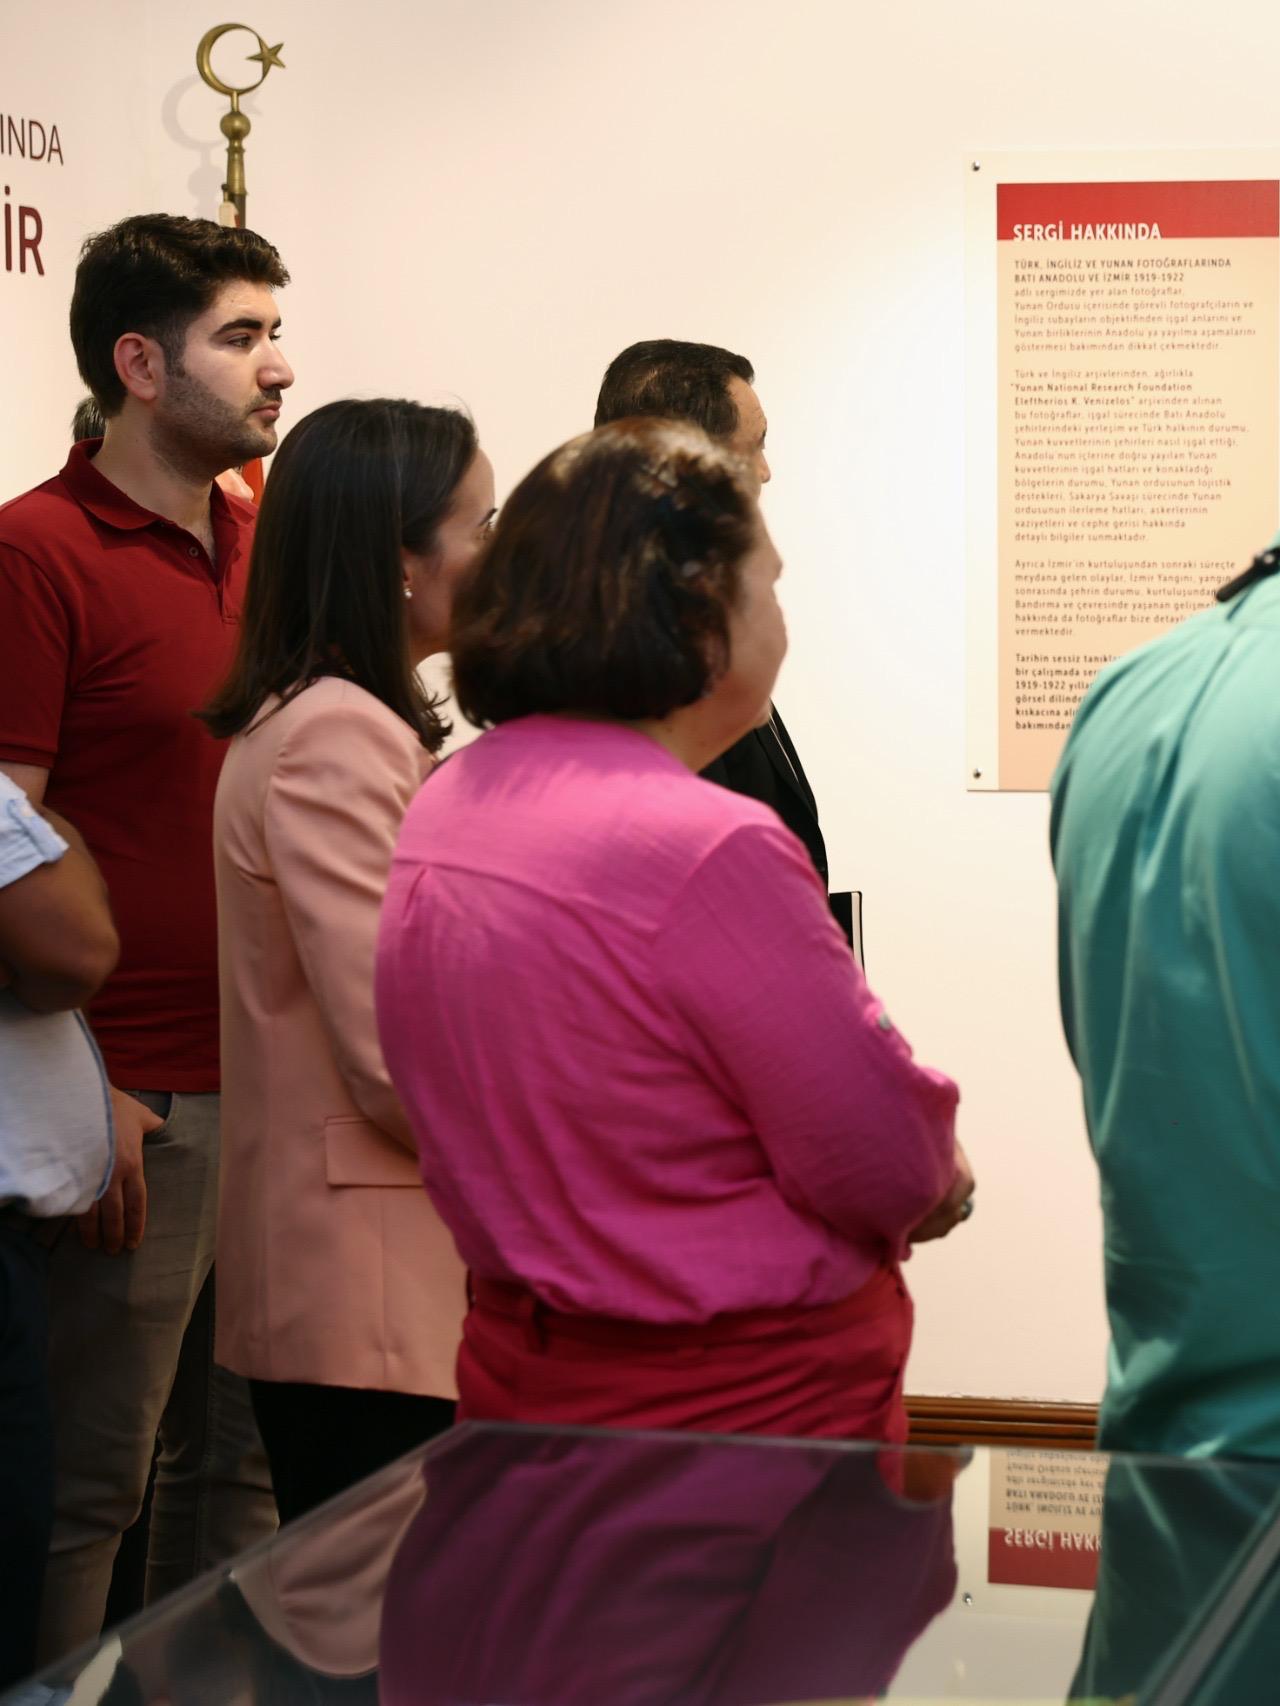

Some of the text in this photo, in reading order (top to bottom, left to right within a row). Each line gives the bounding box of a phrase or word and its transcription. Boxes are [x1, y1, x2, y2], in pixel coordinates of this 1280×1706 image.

[4, 185, 45, 276] İR
[1012, 220, 1162, 242] SERGİ HAKKINDA
[1046, 257, 1082, 269] İNGİLİZ
[1086, 259, 1096, 269] VE
[1100, 259, 1133, 269] YUNAN
[1137, 256, 1231, 268] FOTOĞRAFLARINDA
[1014, 270, 1185, 283] BATI ANADOLU VE İZMİR 1919-1922
[1014, 287, 1032, 297] adlı
[1090, 289, 1105, 299] yer
[1108, 286, 1127, 296] alan
[1015, 301, 1043, 311] Yunan
[1046, 300, 1081, 310] Ordusu
[1243, 301, 1254, 309] ve
[1015, 328, 1043, 338] Yunan
[1047, 383, 1087, 393] National
[1091, 382, 1134, 392] Research
[1137, 382, 1193, 392] Foundation
[1015, 396, 1068, 406] Eleftherios
[1015, 410, 1026, 420] bu
[1186, 409, 1226, 419] Anadolu
[1015, 437, 1044, 447] Yunan
[1188, 450, 1217, 460] Yunan
[1111, 477, 1140, 487] Yunan
[1069, 491, 1106, 504] Sakarya
[1193, 491, 1222, 501] Yunan
[1081, 518, 1109, 531] cephe
[1143, 518, 1186, 528] hakkında
[1015, 559, 1044, 572] Ayrıca
[1161, 559, 1197, 569] sonraki
[1015, 573, 1154, 586] meydana gelen İzmir
[1015, 587, 1067, 597] sonrasında
[1015, 600, 1171, 613] Bandırma ve çevresinde yaşanan
[1015, 614, 1058, 624] hakkında
[1061, 614, 1072, 624] da
[1130, 614, 1150, 624] bize
[1016, 654, 1081, 664] Tarihin sessiz
[1016, 668, 1080, 681] bir çalışmada
[1016, 681, 1066, 691] 1919-1922
[1016, 695, 1046, 707] görsel
[1016, 708, 1060, 718] kıskacına
